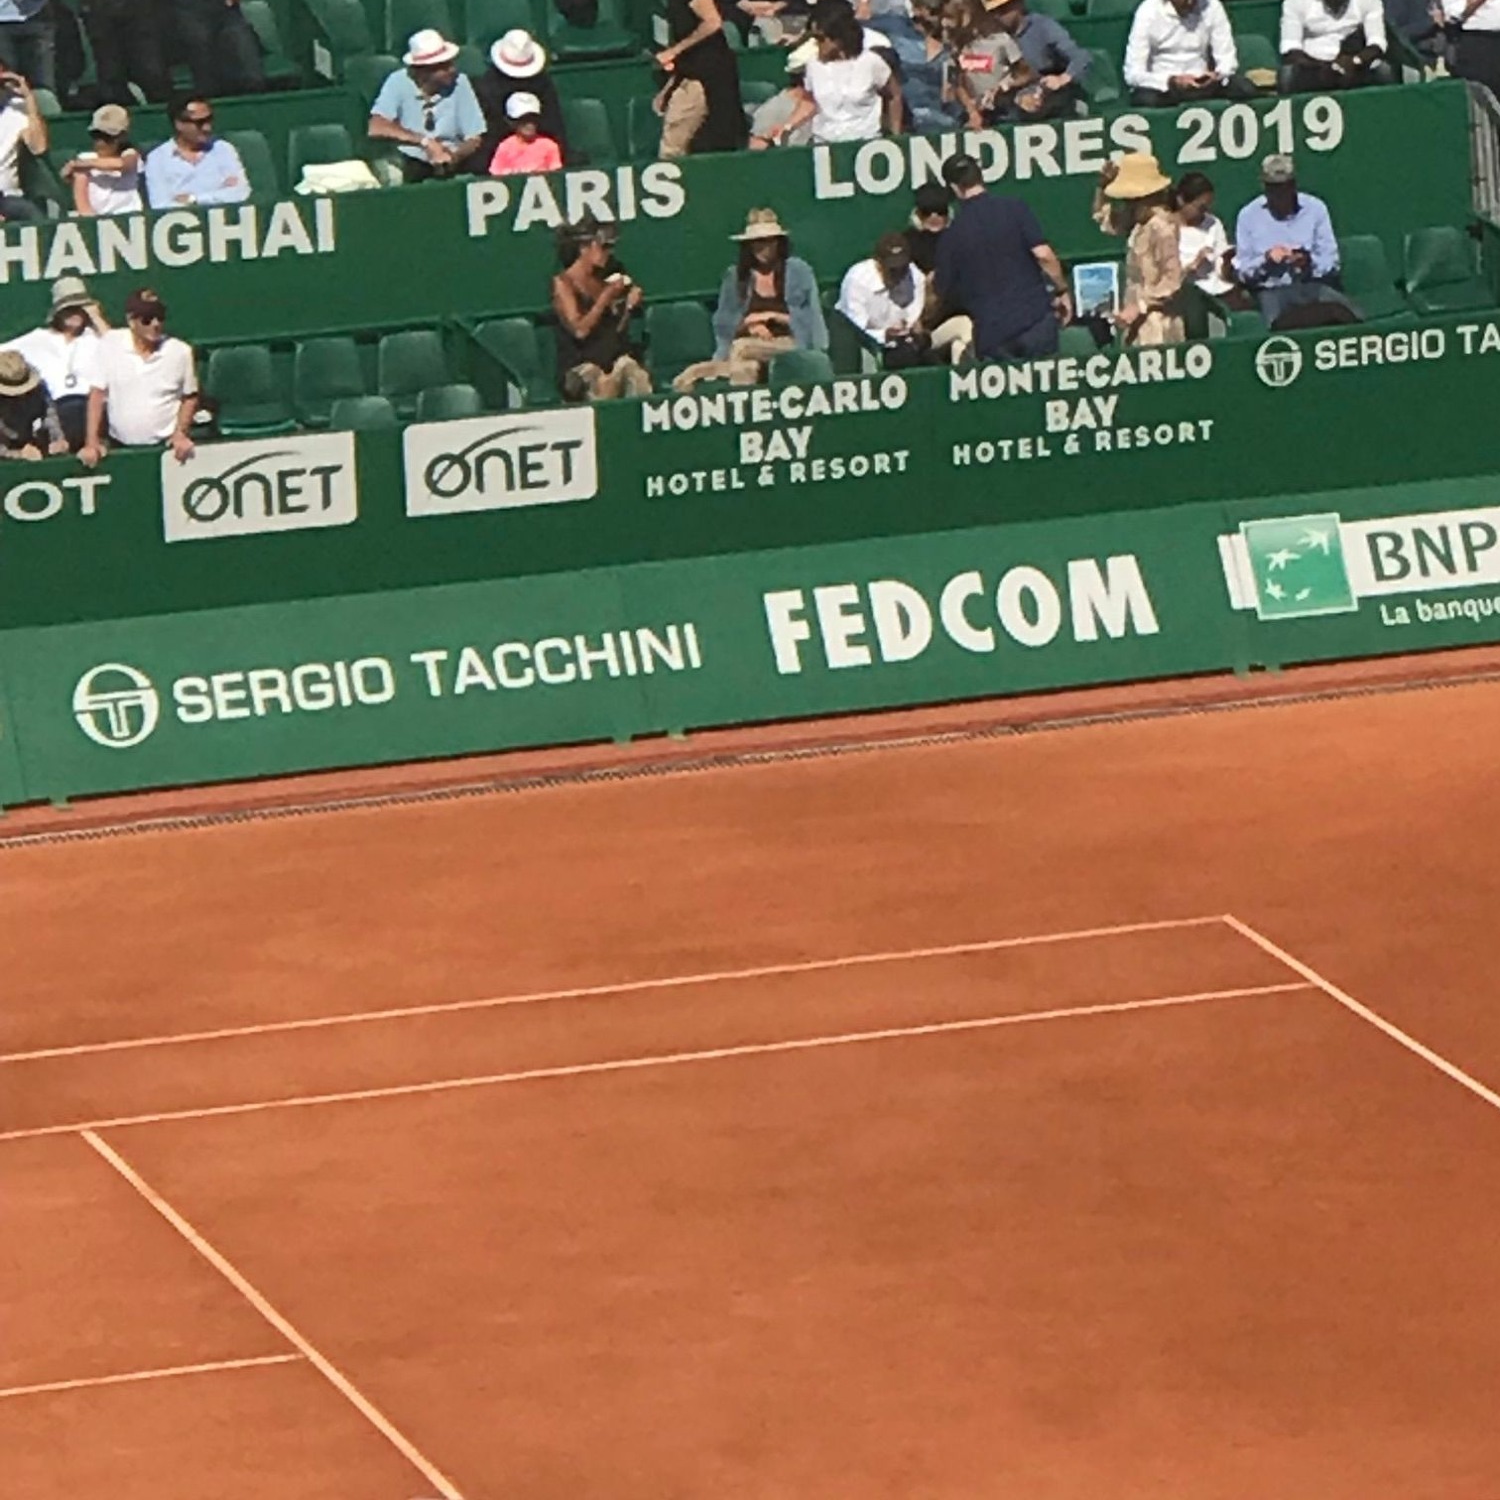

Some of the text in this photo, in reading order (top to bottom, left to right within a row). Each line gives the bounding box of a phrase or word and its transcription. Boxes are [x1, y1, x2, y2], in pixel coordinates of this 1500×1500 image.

[813, 95, 1345, 200] LONDRES 2019
[466, 162, 686, 237] PARIS
[1314, 327, 1446, 372] SERGIO
[1045, 395, 1119, 433] BAY
[739, 426, 813, 465] BAY
[952, 419, 1214, 466] HOTEL & RESORT
[647, 450, 910, 497] HOTEL & RESORT
[1366, 518, 1499, 583] BNP
[764, 554, 1159, 675] FEDCOM
[1380, 602, 1408, 626] La
[173, 622, 702, 724] SERGIO TACCHINI
